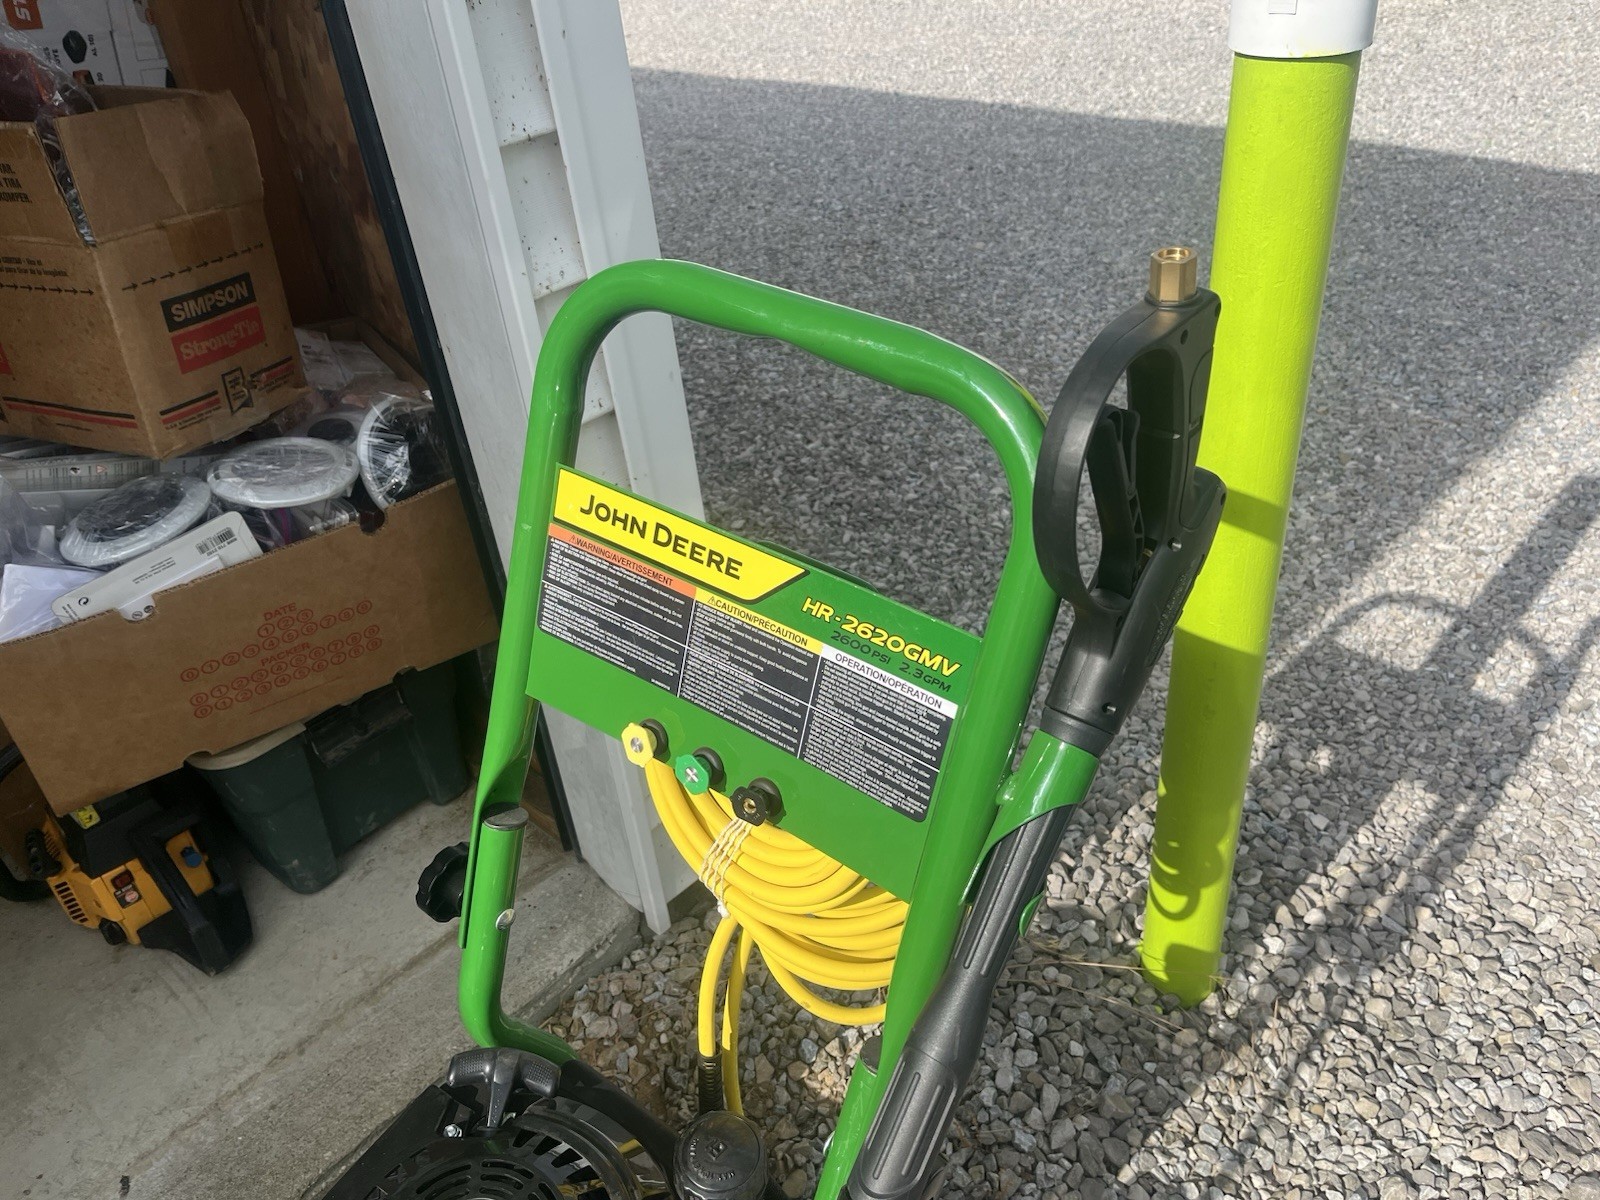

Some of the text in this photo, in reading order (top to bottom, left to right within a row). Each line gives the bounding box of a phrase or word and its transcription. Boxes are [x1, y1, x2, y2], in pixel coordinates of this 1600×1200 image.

[170, 281, 249, 323] SIMPSON
[580, 494, 647, 540] JOHN
[652, 521, 744, 581] DEERE
[576, 538, 674, 588] WARNING/AVERTISSEMENT
[263, 602, 297, 621] DATE
[715, 599, 809, 647] CAUTION/PRÉCAUTION
[260, 642, 311, 667] PACKER
[801, 596, 963, 678] HR-2620GMV
[835, 652, 943, 710] OPERATION/OPÉRATION
